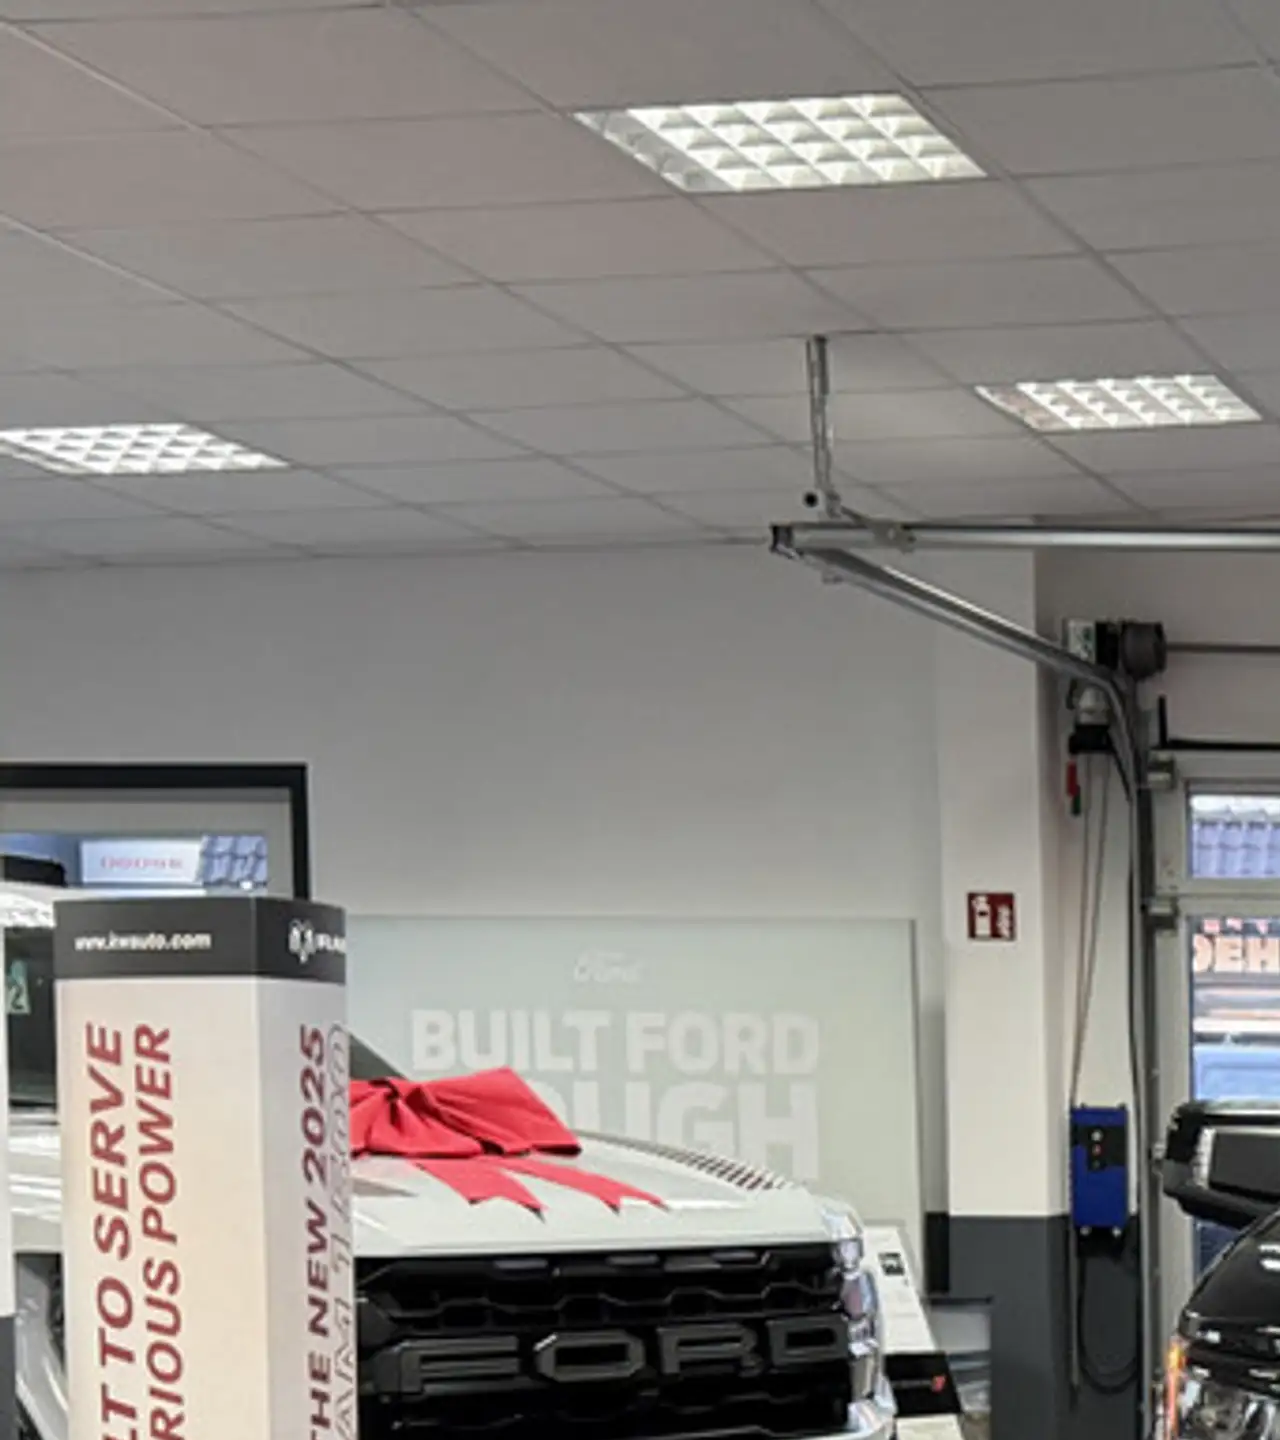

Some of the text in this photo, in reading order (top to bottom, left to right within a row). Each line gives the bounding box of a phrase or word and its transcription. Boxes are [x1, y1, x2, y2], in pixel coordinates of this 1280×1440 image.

[299, 1024, 328, 1188] 2025
[411, 1009, 819, 1075] BUILT FORD
[85, 1022, 133, 1261] SERVE
[133, 1024, 178, 1247] POWER
[95, 1276, 136, 1368] TO
[304, 1198, 330, 1338] NEW
[373, 1314, 850, 1395] FORD
